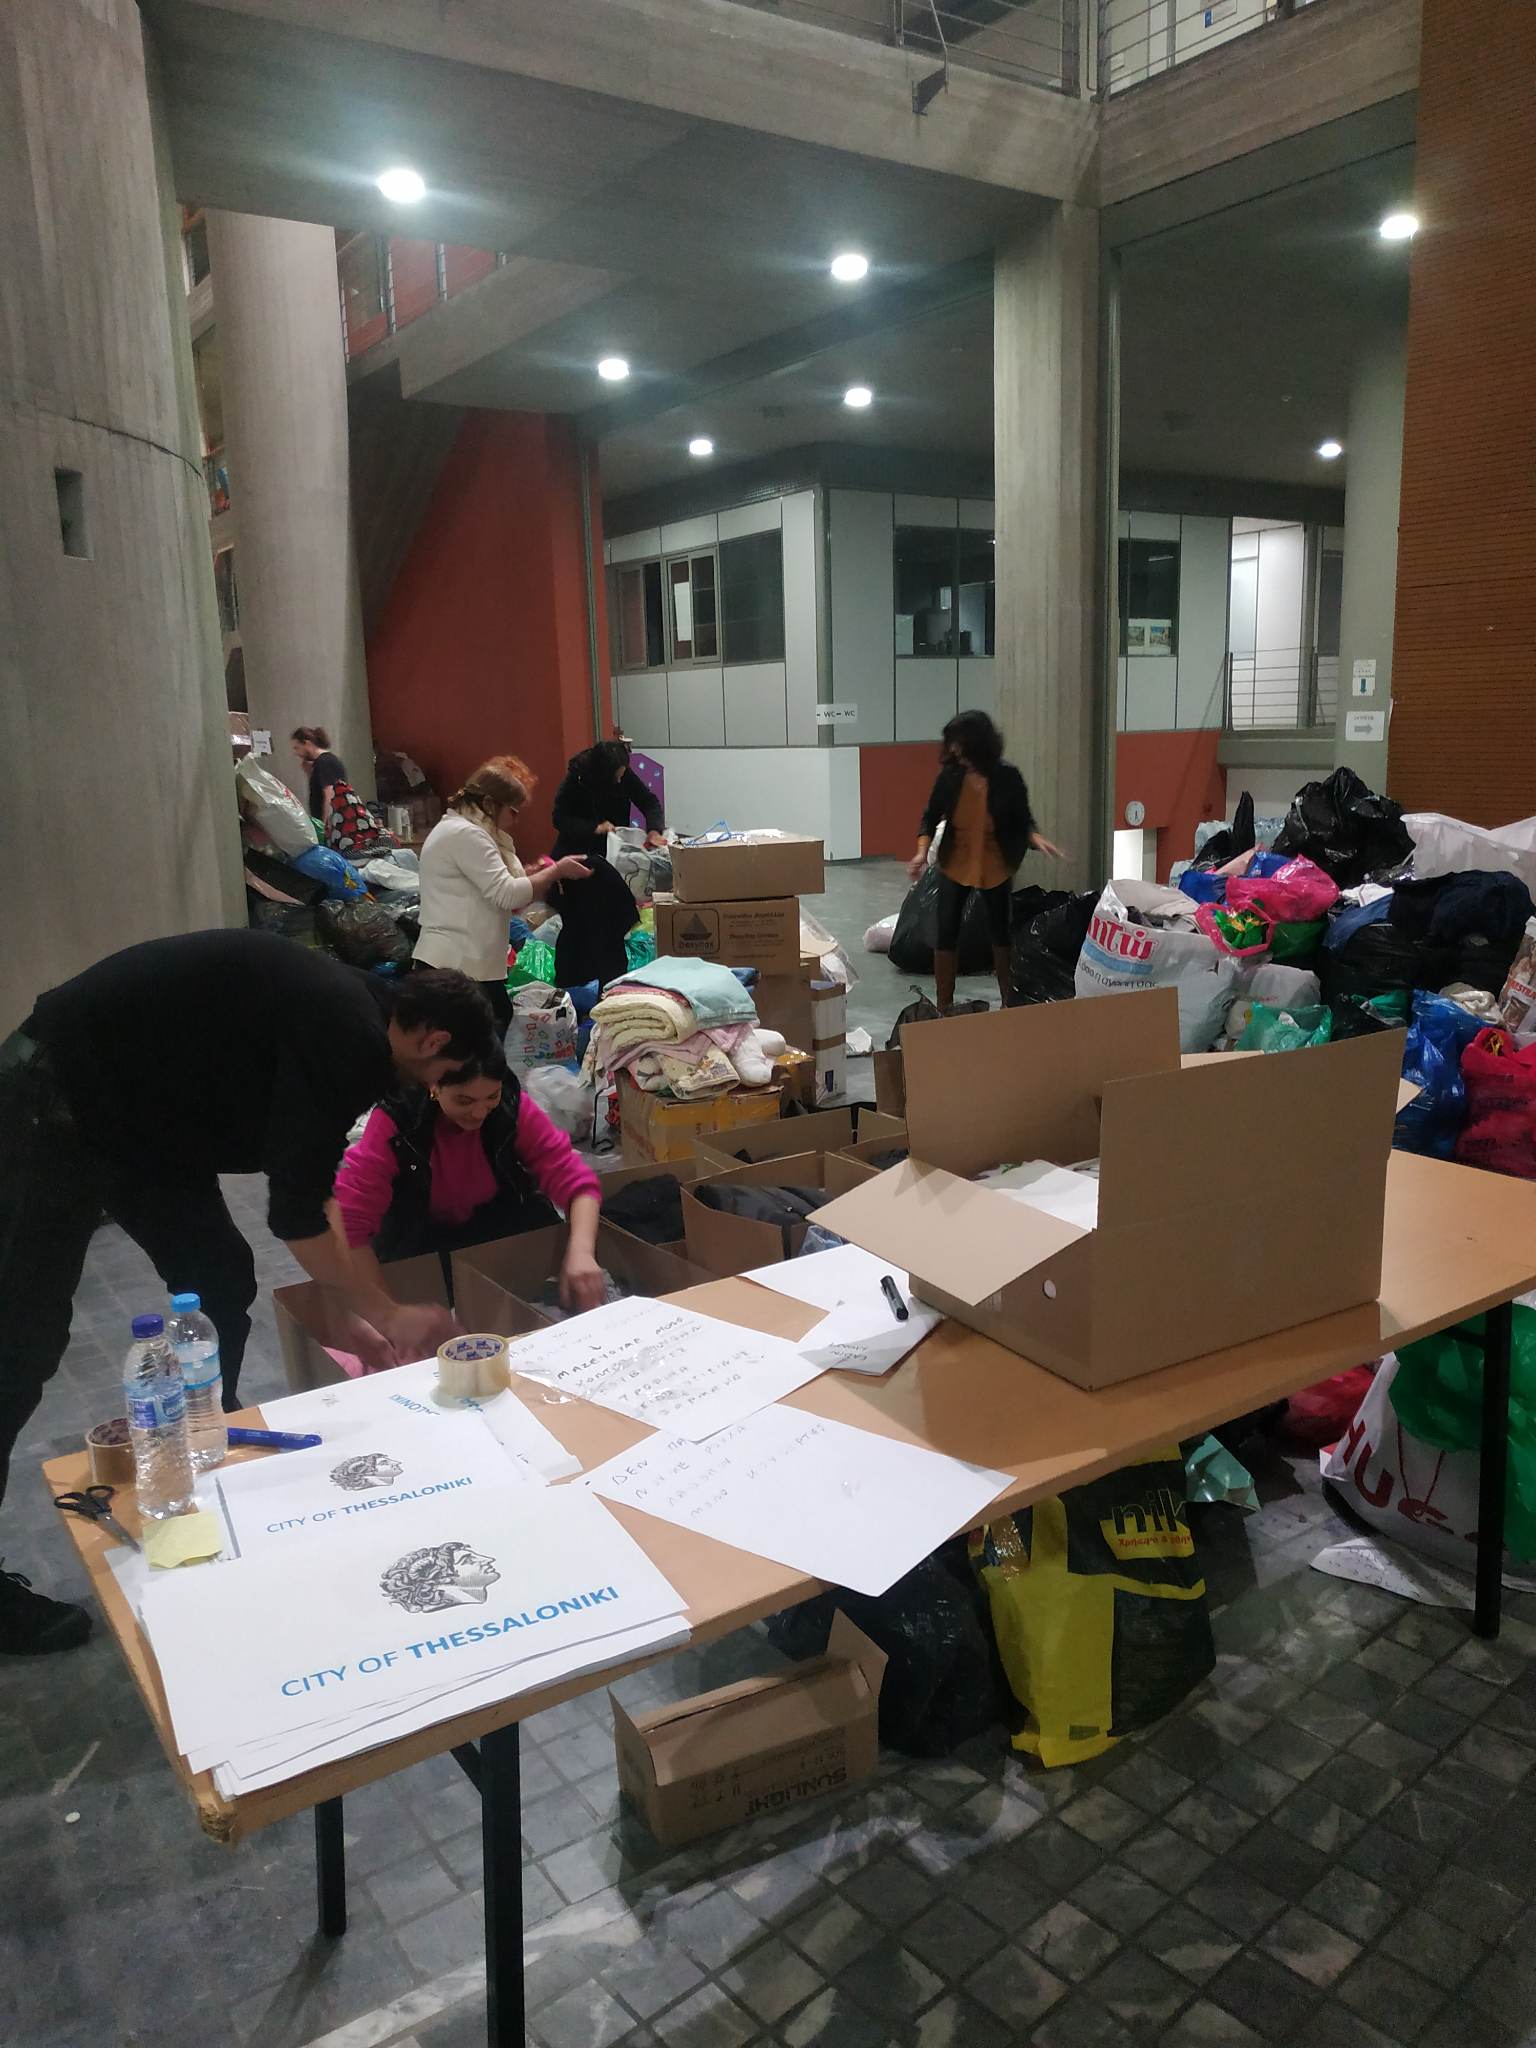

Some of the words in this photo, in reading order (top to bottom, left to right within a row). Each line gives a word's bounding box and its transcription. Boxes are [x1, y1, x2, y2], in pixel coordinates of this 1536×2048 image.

[267, 1517, 306, 1533] CITY
[312, 1509, 338, 1523] OF
[341, 1476, 473, 1515] THESSALONIKI
[281, 1665, 347, 1698] CITY
[358, 1650, 399, 1676] OF
[405, 1585, 619, 1660] THESSALONIKI
